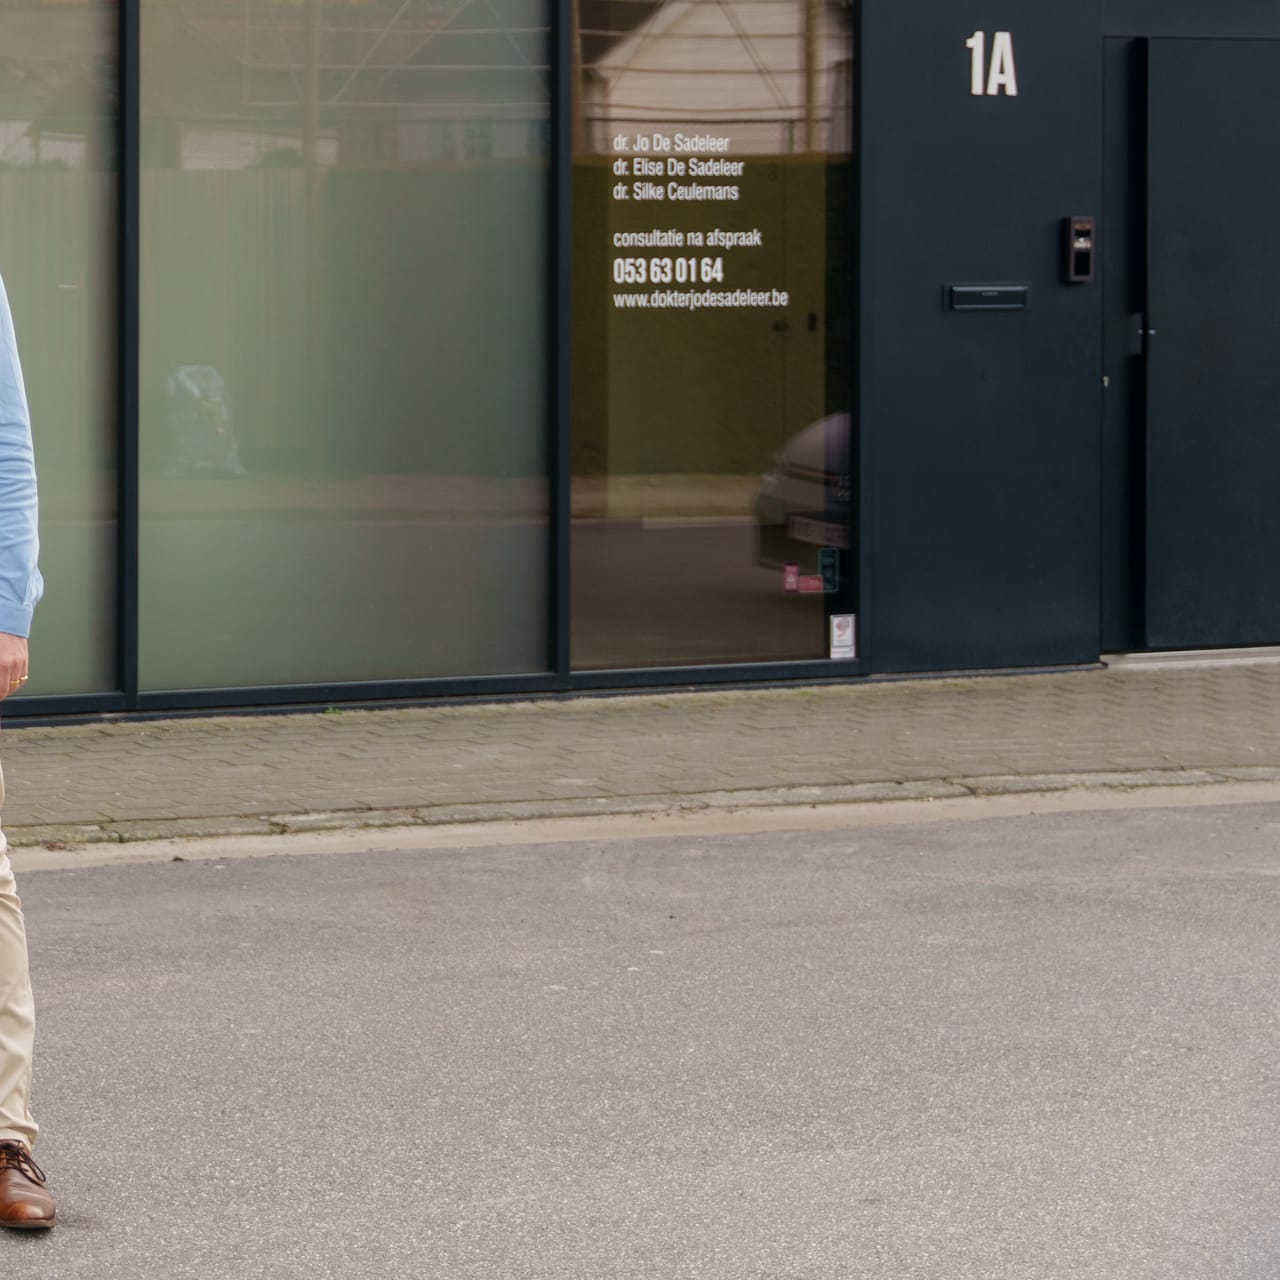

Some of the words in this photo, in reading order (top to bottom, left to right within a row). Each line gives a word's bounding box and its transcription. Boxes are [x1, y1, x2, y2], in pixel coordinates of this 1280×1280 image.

[965, 30, 1018, 97] 1A
[612, 135, 630, 151] dr.
[632, 134, 649, 151] Jo
[652, 134, 671, 151] De
[673, 133, 730, 152] Sadeleer
[612, 159, 630, 176] dr.
[632, 157, 665, 176] Elise
[666, 158, 686, 176] De
[688, 158, 745, 177] Sadeleer
[612, 183, 630, 200] dr.
[632, 181, 665, 200] Silke
[667, 181, 740, 201] Ceulemans
[612, 228, 684, 248] consultatie
[686, 231, 704, 247] na
[706, 228, 762, 250] afspraak
[612, 257, 647, 283] 053
[649, 257, 673, 283] 63
[675, 257, 697, 283] 01
[700, 257, 724, 283] 64
[612, 288, 789, 310] www.dokterjodesadeleer.be
